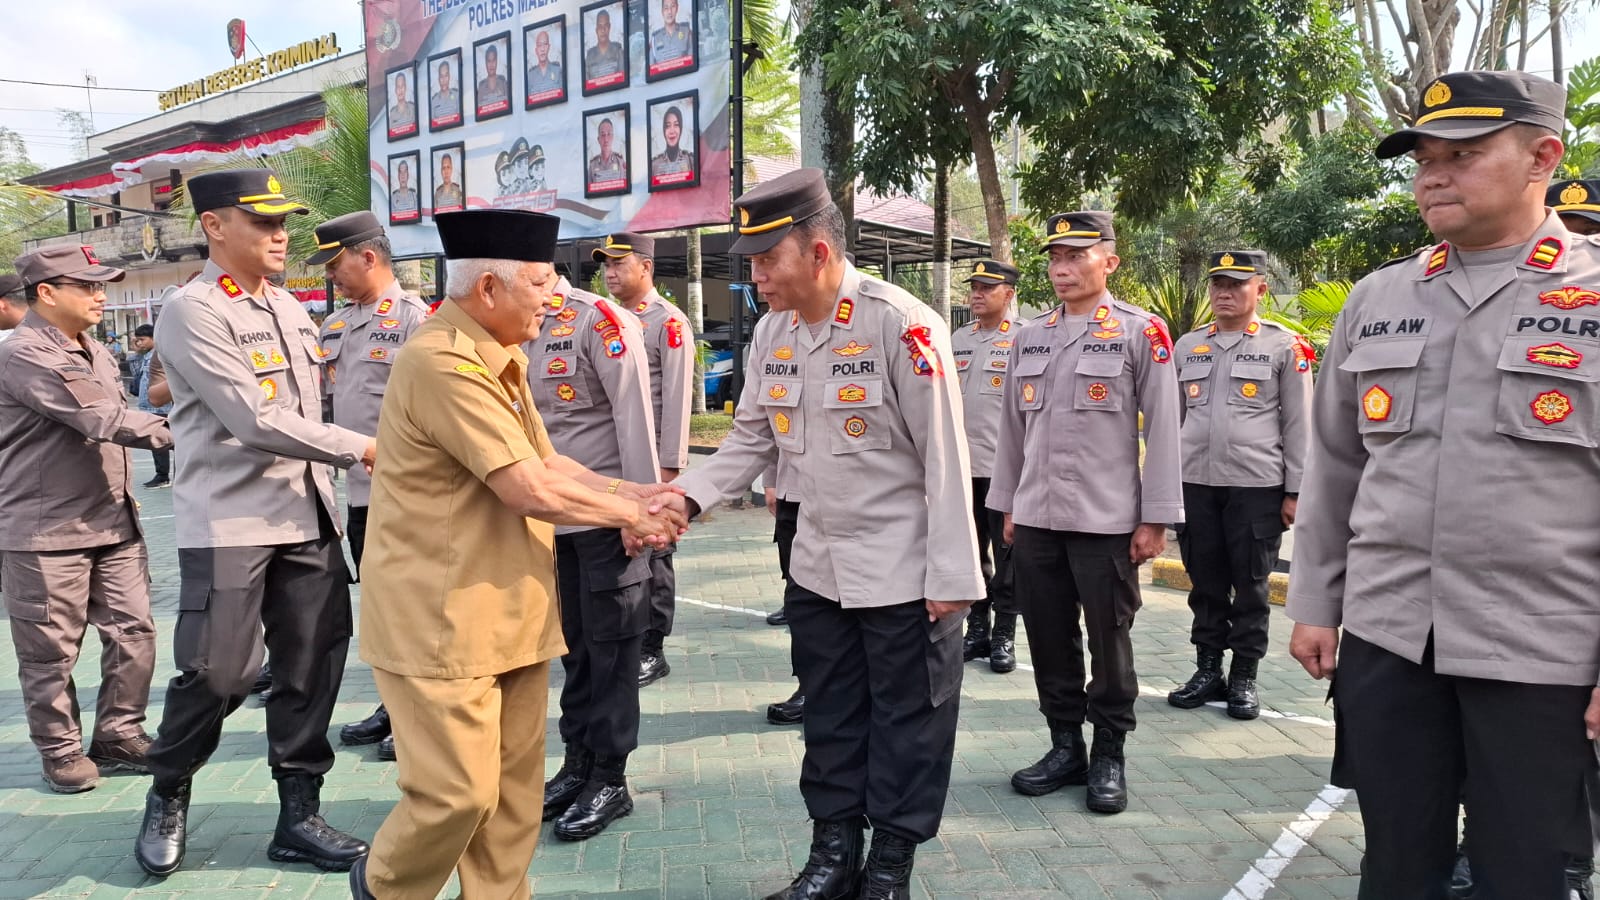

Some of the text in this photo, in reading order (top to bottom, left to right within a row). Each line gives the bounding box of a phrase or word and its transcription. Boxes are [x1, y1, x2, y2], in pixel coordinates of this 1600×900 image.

[469, 0, 514, 30] POLRES
[158, 32, 341, 110] SATUAN RESERSE KRIMINAL
[1359, 318, 1425, 340] ALEK AW
[1517, 316, 1600, 337] POLR
[369, 332, 400, 343] POLRI
[545, 339, 573, 353] POLRI
[1021, 343, 1123, 355] INDRA POLRI
[1186, 354, 1270, 363] YOYOK POLRI
[765, 360, 875, 376] BUDI.M POLRI
